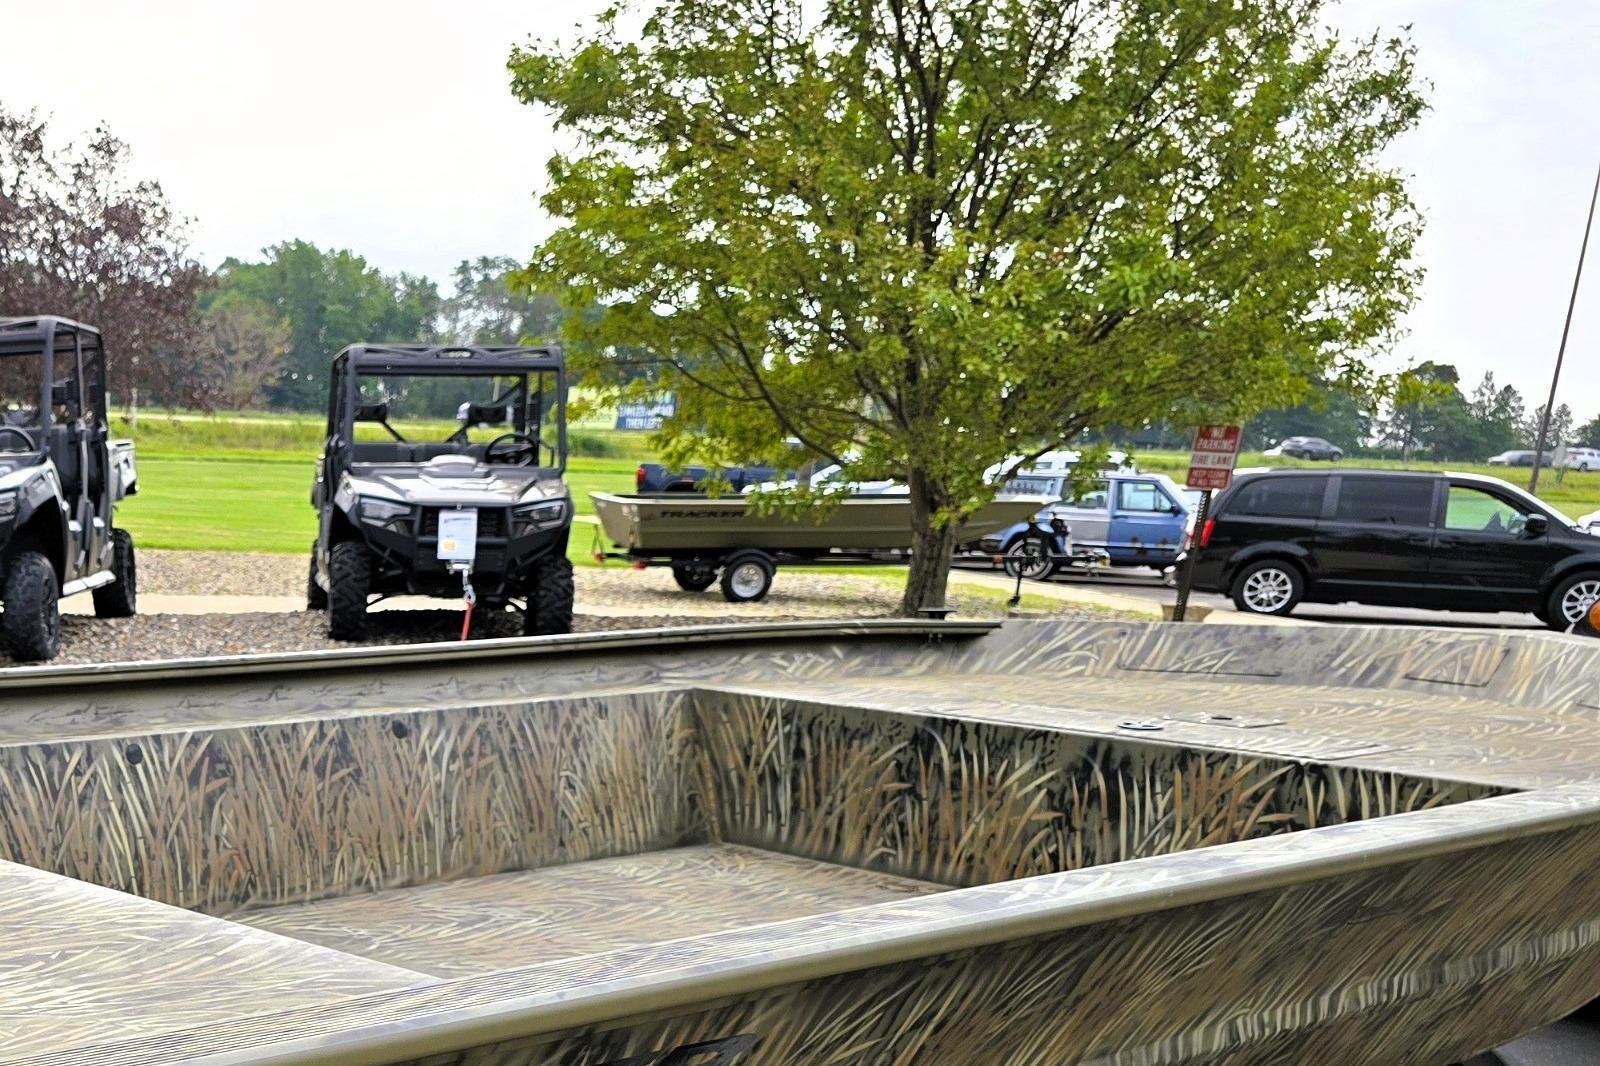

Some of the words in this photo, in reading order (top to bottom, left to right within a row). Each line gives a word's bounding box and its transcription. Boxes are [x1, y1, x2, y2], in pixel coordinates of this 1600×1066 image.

[1196, 439, 1234, 450] PARKING
[1193, 454, 1209, 466] FIRE
[1211, 454, 1233, 466] LANE
[660, 511, 745, 519] TRACKER
